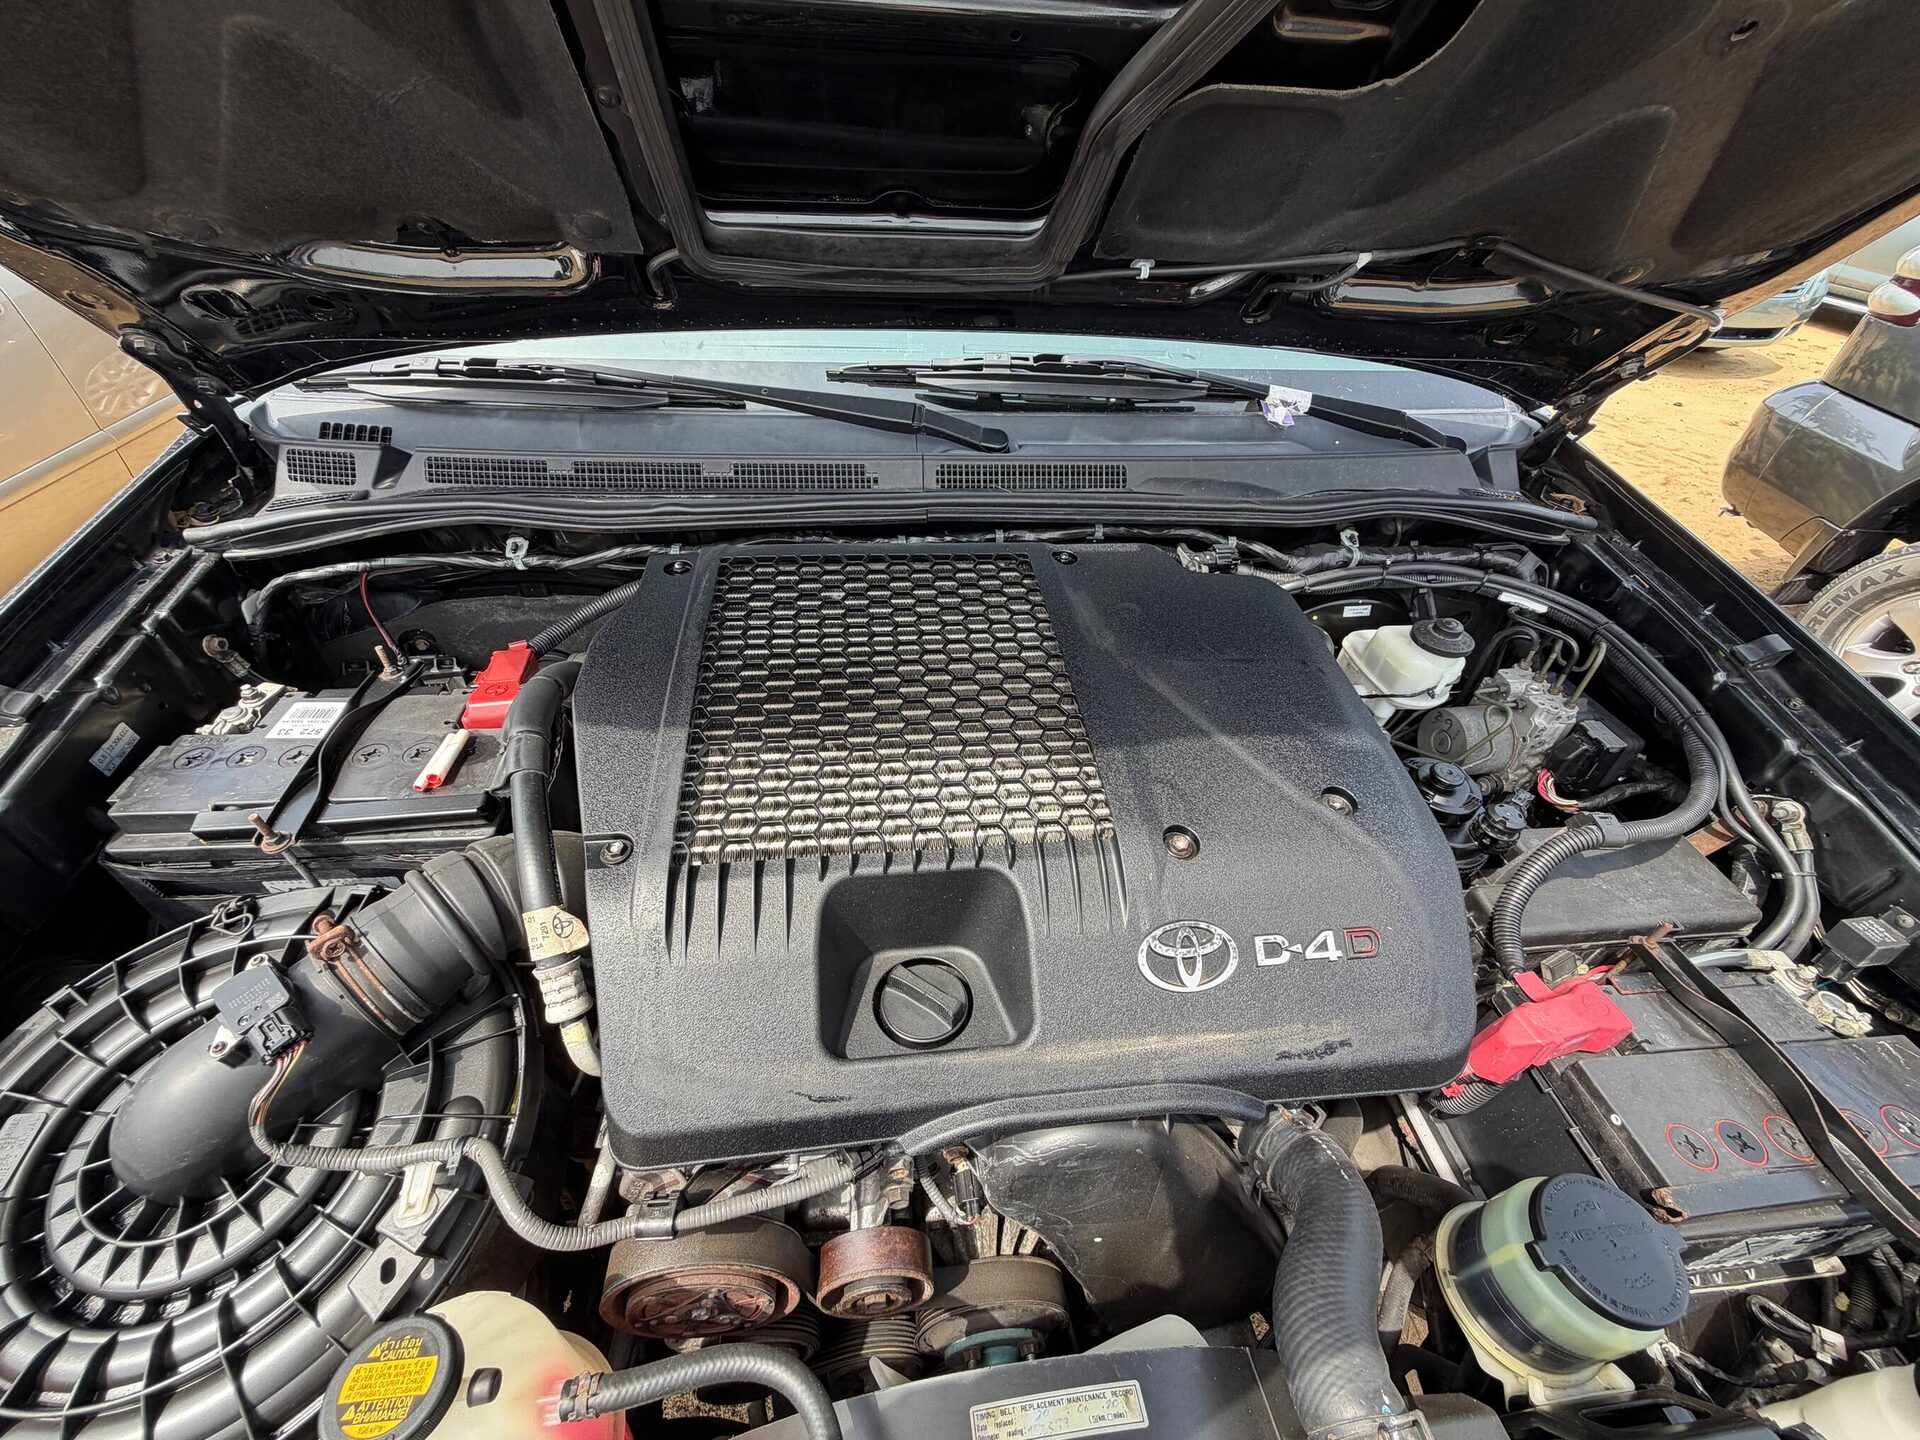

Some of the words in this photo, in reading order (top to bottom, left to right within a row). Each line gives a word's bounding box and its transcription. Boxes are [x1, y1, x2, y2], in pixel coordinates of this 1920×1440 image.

[1806, 564, 1907, 633] REMAX
[1253, 926, 1382, 968] D-4D
[380, 1347, 420, 1361] CAUTION
[375, 1372, 391, 1380] OPEN
[393, 1370, 412, 1379] WHEN
[356, 1395, 414, 1412] ATTENTION
[975, 1410, 996, 1422] TIMING
[999, 1406, 1016, 1417] BELT
[1111, 1388, 1134, 1399] RECORD
[976, 1423, 988, 1432] Date
